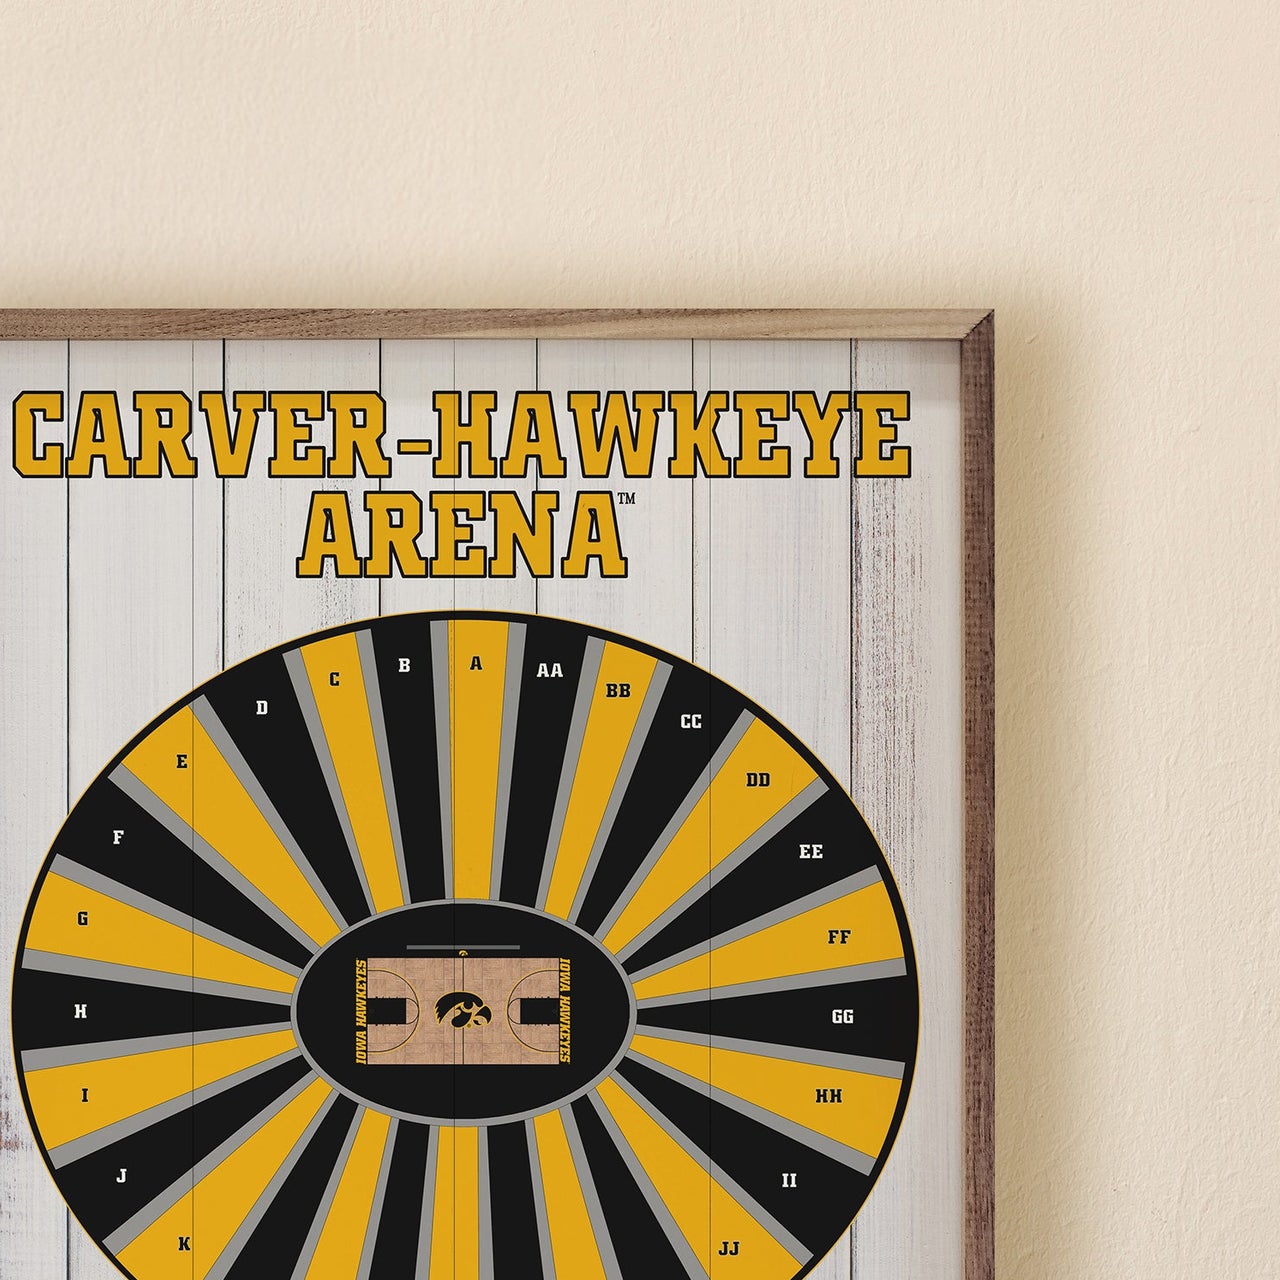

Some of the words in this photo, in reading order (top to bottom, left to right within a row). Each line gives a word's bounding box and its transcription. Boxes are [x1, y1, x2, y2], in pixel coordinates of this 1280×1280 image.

[12, 391, 911, 478] CARVER-HAWKEYE
[398, 657, 411, 673] B
[469, 655, 483, 671] A
[536, 662, 564, 678] AA
[329, 671, 340, 687] C
[605, 683, 631, 698] BB
[256, 700, 268, 715] D
[680, 713, 702, 729] CC
[176, 754, 188, 769] E
[746, 772, 770, 787] DD
[112, 829, 125, 845] F
[799, 844, 824, 859] EE
[77, 911, 88, 926] G
[827, 929, 851, 945] FF
[559, 957, 571, 992] IOWA
[355, 959, 367, 1028] HAWKEYES
[74, 1003, 88, 1019] H
[831, 1009, 854, 1024] GG
[559, 995, 571, 1064] HAWKEYES
[355, 1030, 367, 1065] IOWA
[81, 1088, 89, 1103] I
[815, 1088, 843, 1104] HH
[116, 1168, 127, 1184] J
[781, 1172, 797, 1188] II
[178, 1236, 191, 1251] K
[718, 1241, 740, 1256] JJ
